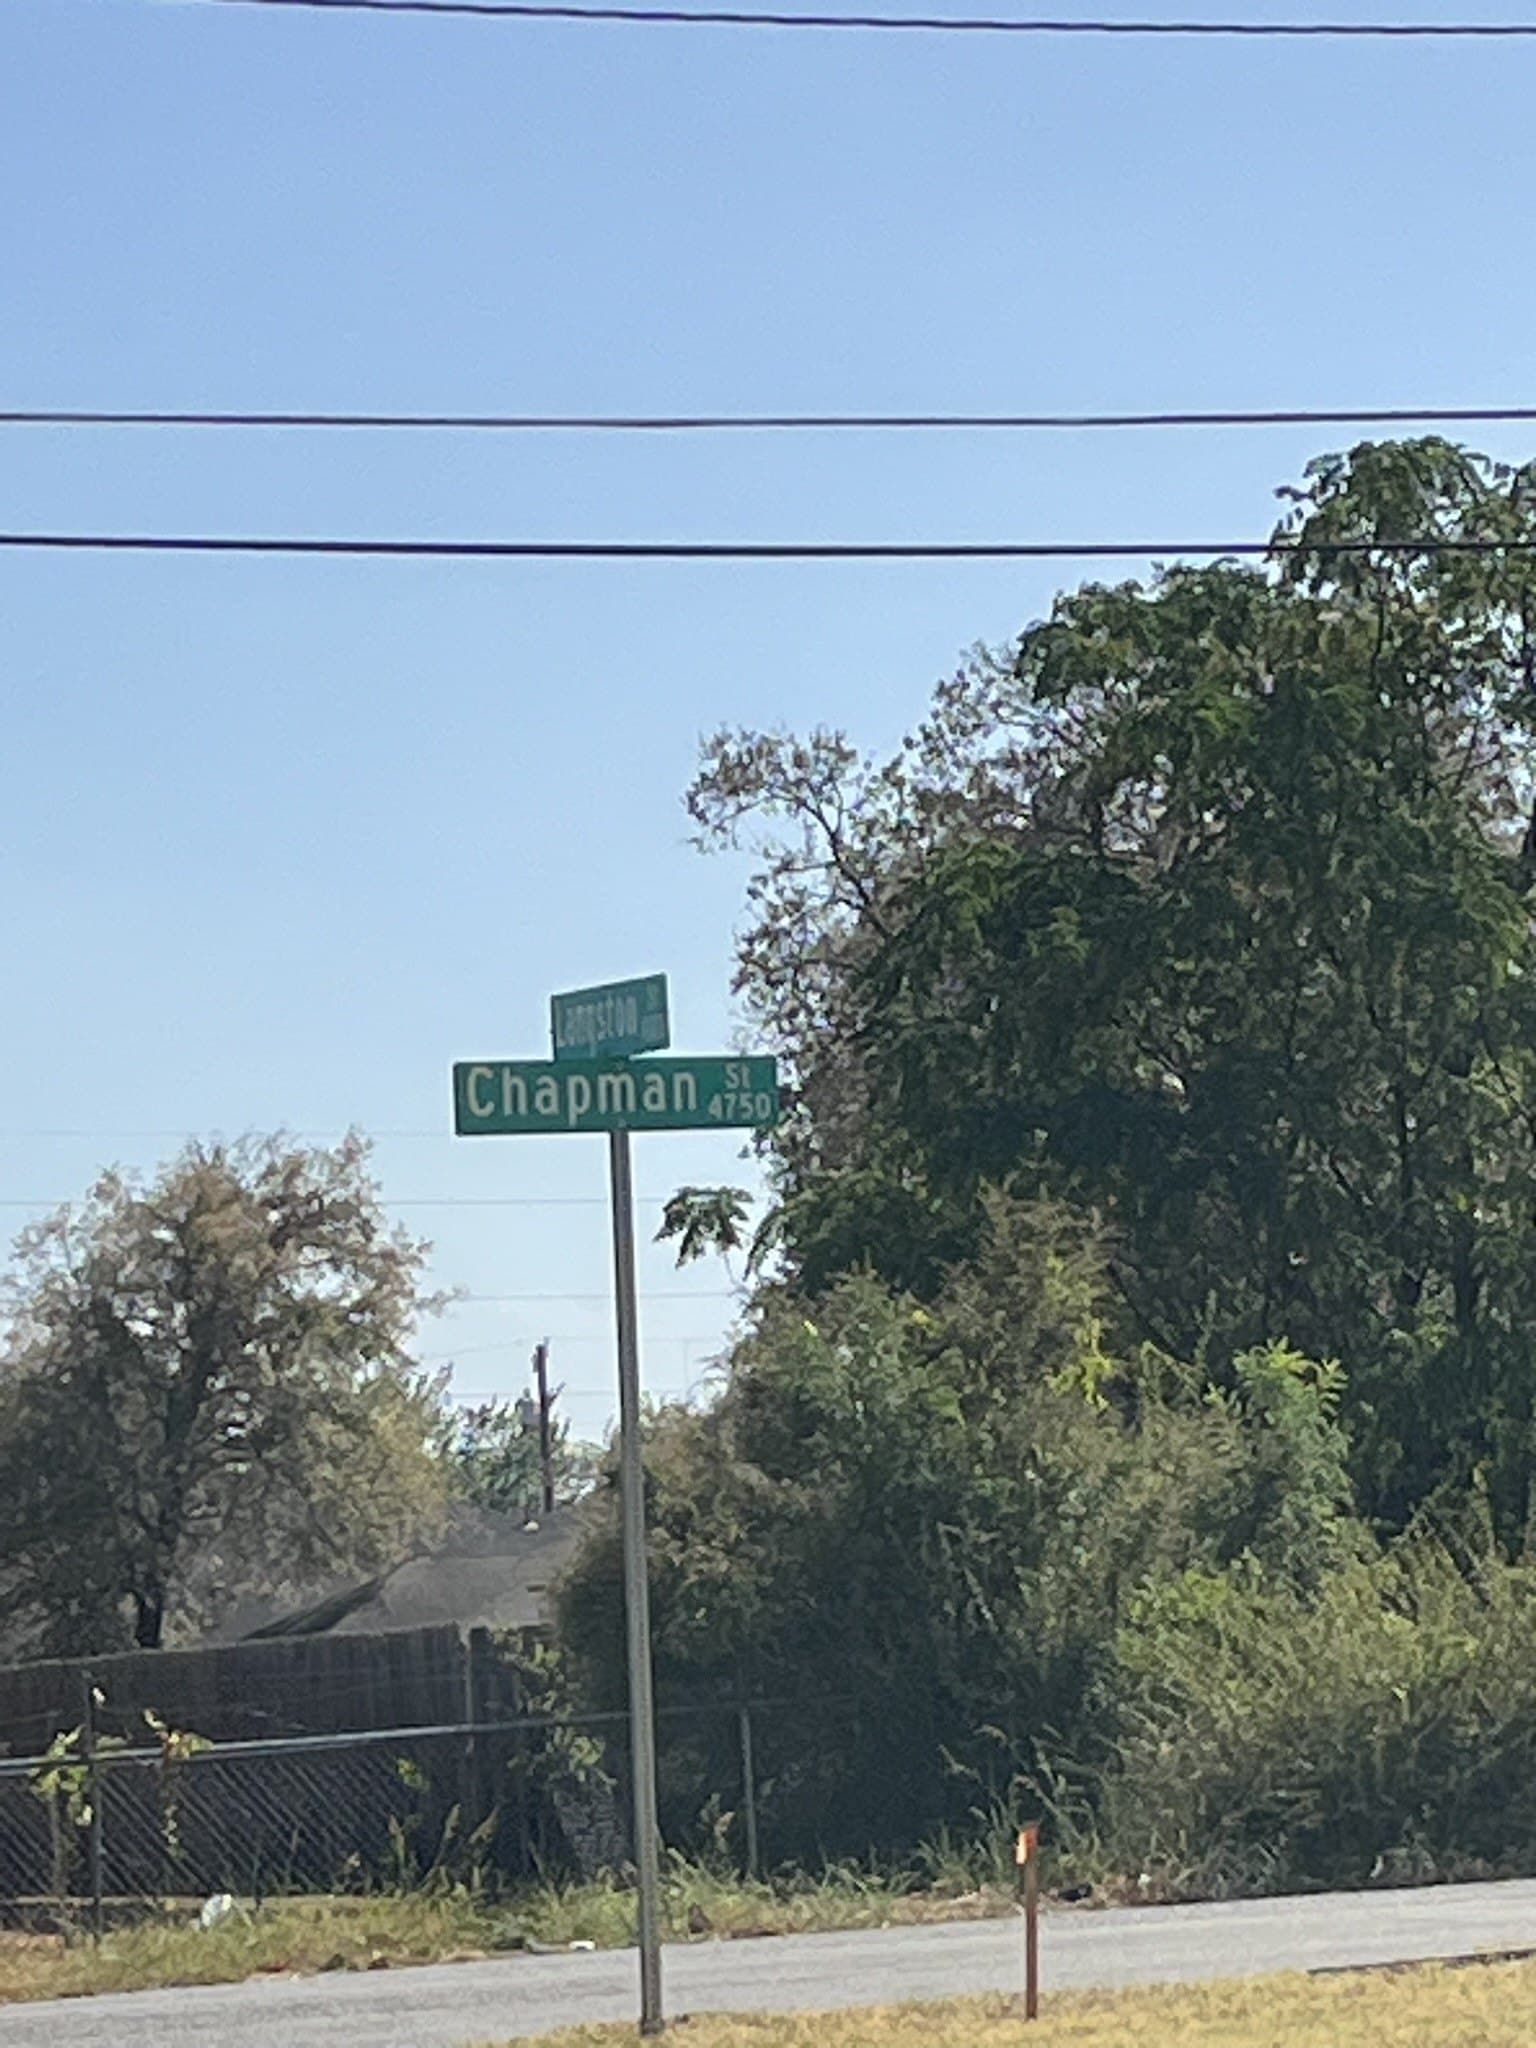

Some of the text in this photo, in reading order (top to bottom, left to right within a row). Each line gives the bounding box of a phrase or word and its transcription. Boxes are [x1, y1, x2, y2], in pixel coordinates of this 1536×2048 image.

[466, 1062, 750, 1127] Chapman St
[708, 1092, 772, 1120] 4750
